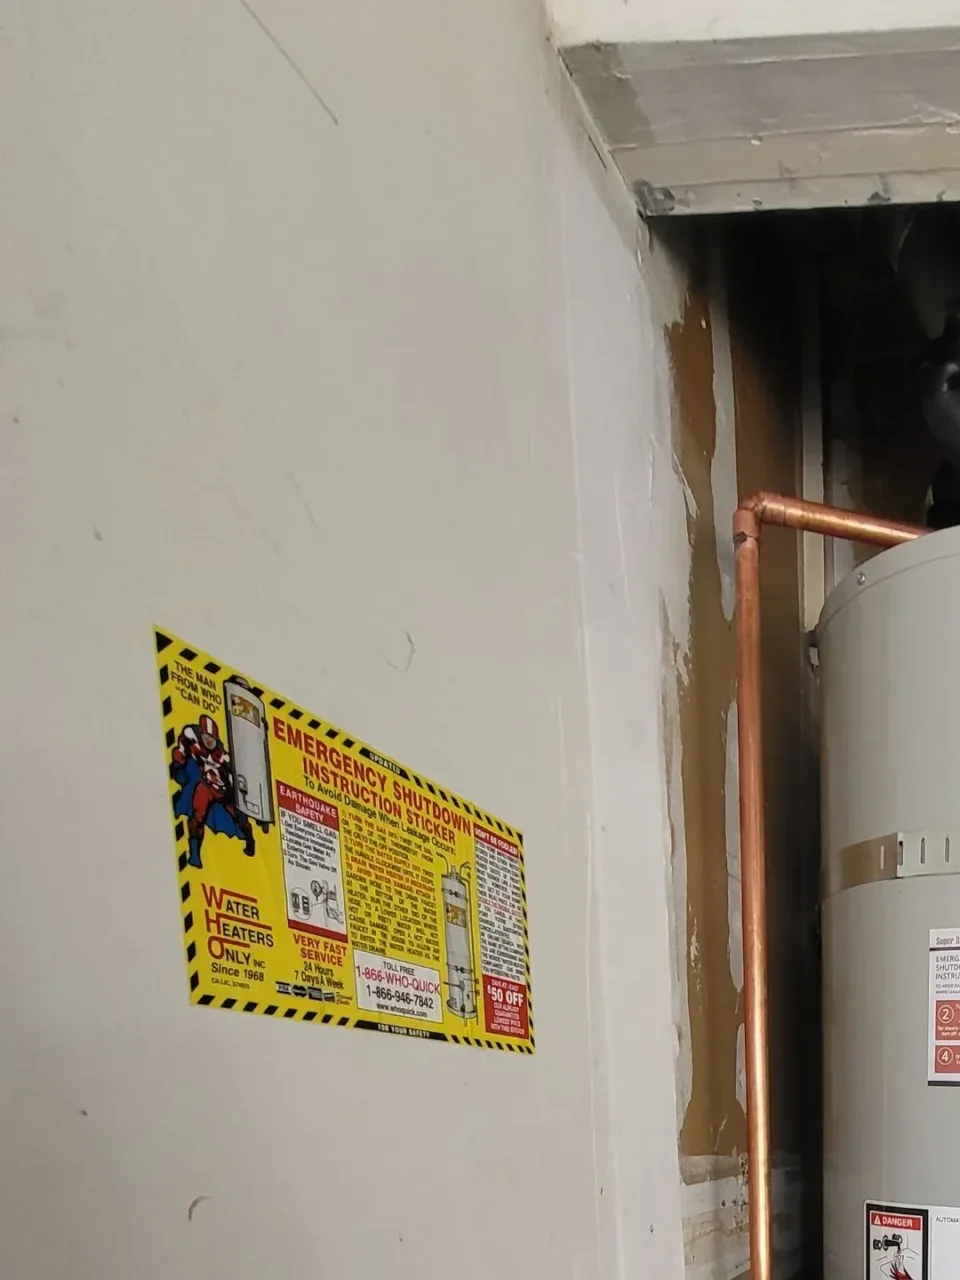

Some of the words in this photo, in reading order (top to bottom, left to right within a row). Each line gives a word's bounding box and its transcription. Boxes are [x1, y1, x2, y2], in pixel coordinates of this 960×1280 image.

[174, 660, 194, 679] THE
[195, 672, 217, 691] MAN
[171, 671, 198, 693] FROM
[200, 686, 222, 706] WHO
[369, 752, 401, 775] UPDATED
[273, 716, 388, 792] EMERGENCY
[393, 781, 472, 836] SHUTDOWN
[280, 786, 337, 818] EARTHQUAKE
[303, 757, 402, 819] INSTRUCTION
[407, 810, 456, 845] STICKER
[304, 776, 315, 788] To
[317, 781, 342, 803] Avoid
[344, 794, 378, 819] Damage
[378, 811, 400, 830] When
[401, 821, 431, 845] Leakage
[288, 813, 301, 825] YOU
[303, 819, 323, 833] SMELL
[295, 803, 324, 823] SAFETY
[200, 882, 260, 920] WATER
[204, 909, 275, 948] HEATERS
[207, 935, 251, 966] ONLY
[253, 959, 266, 969] INC
[293, 933, 321, 949] VERY
[323, 941, 347, 957] FAST
[936, 937, 954, 946] Super
[300, 947, 343, 967] SERVICE
[383, 961, 399, 973] TOLL
[399, 965, 415, 976] FREE
[211, 962, 240, 977] Since
[244, 969, 264, 982] 1968
[294, 970, 299, 981] 7
[301, 971, 320, 986] Days
[326, 976, 344, 990] Week
[304, 961, 312, 972] 24
[314, 963, 334, 978] Hours
[356, 965, 441, 994] 1-866-WHO-QUICK
[366, 984, 434, 1009] 1-866-946-7842
[487, 984, 503, 1003] $50
[505, 990, 524, 1007] OFF
[376, 1002, 427, 1018] www.whoquick.com
[942, 1009, 950, 1020] 2
[377, 1024, 389, 1032] FOR
[391, 1025, 408, 1035] YOUR
[409, 1028, 430, 1039] SAFETY
[941, 1050, 949, 1061] 4
[882, 1216, 913, 1228] DANGER
